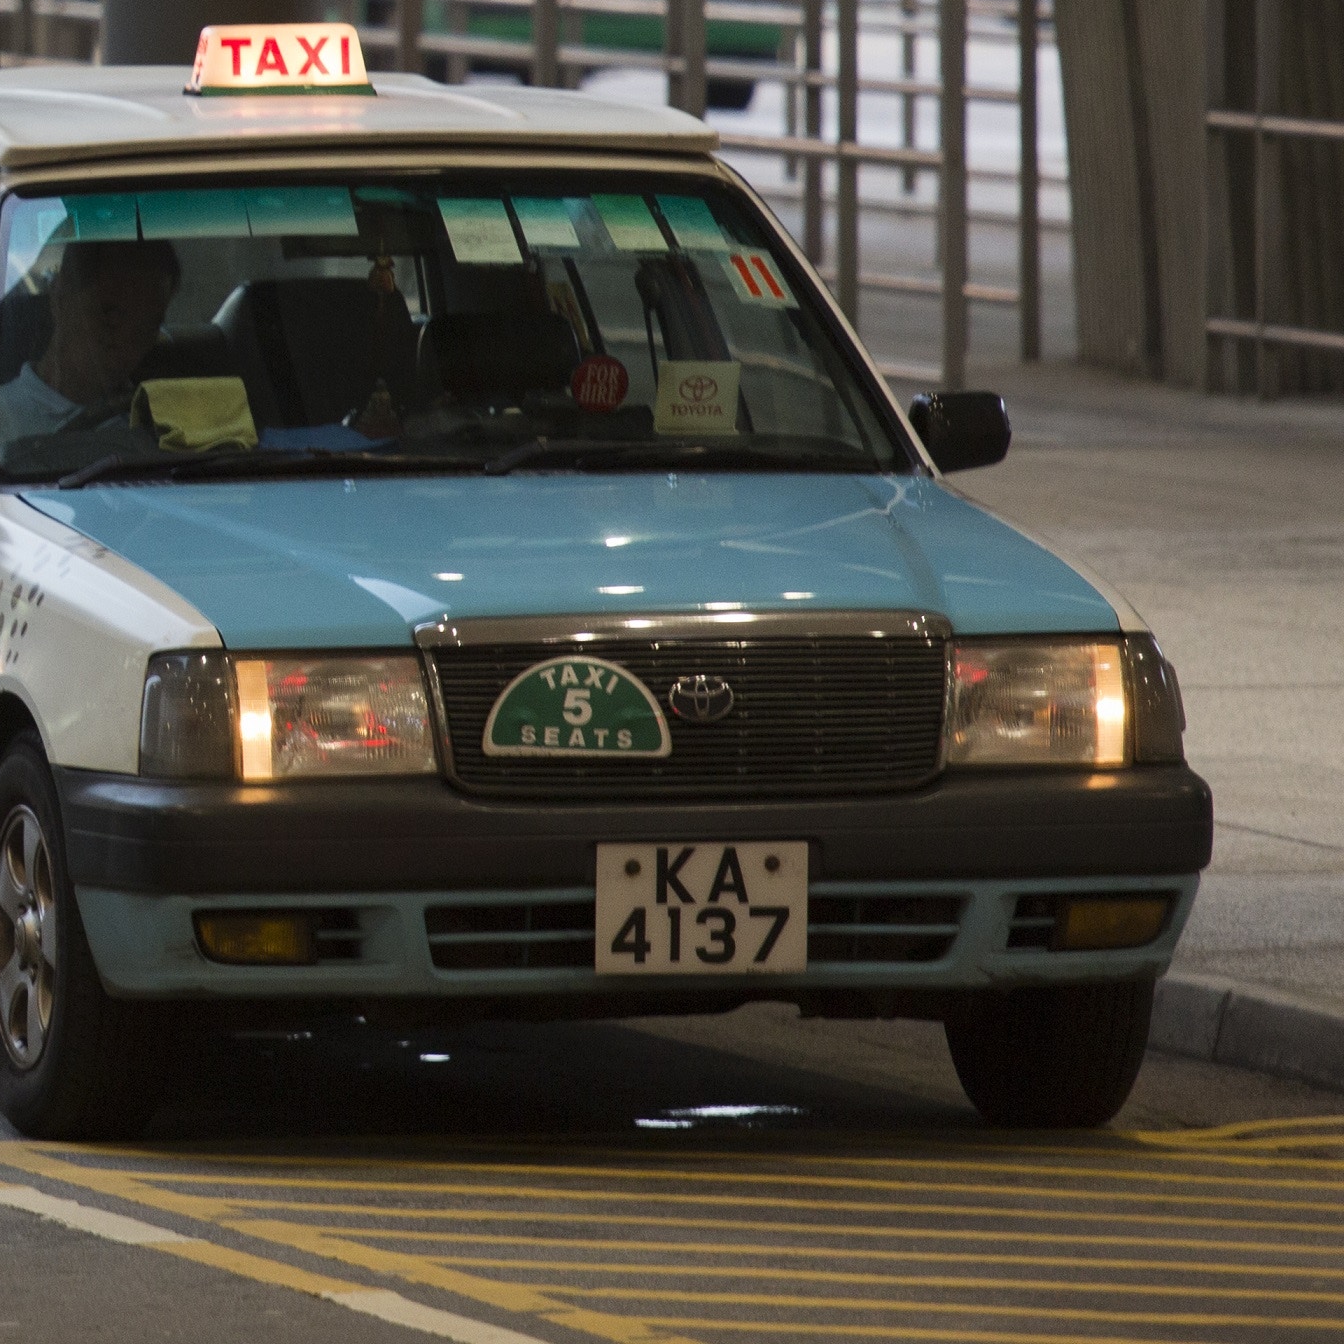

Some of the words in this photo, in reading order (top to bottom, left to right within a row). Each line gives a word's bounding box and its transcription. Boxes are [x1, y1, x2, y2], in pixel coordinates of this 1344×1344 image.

[220, 36, 351, 77] TAXI
[729, 253, 786, 300] 11
[586, 362, 620, 386] FOR
[579, 383, 620, 404] HIRE
[670, 402, 724, 417] TOYOTA
[539, 664, 620, 695] TAXI
[562, 688, 593, 726] 5
[521, 724, 633, 749] SEATS
[655, 846, 749, 904] KA
[611, 906, 790, 965] 4137
